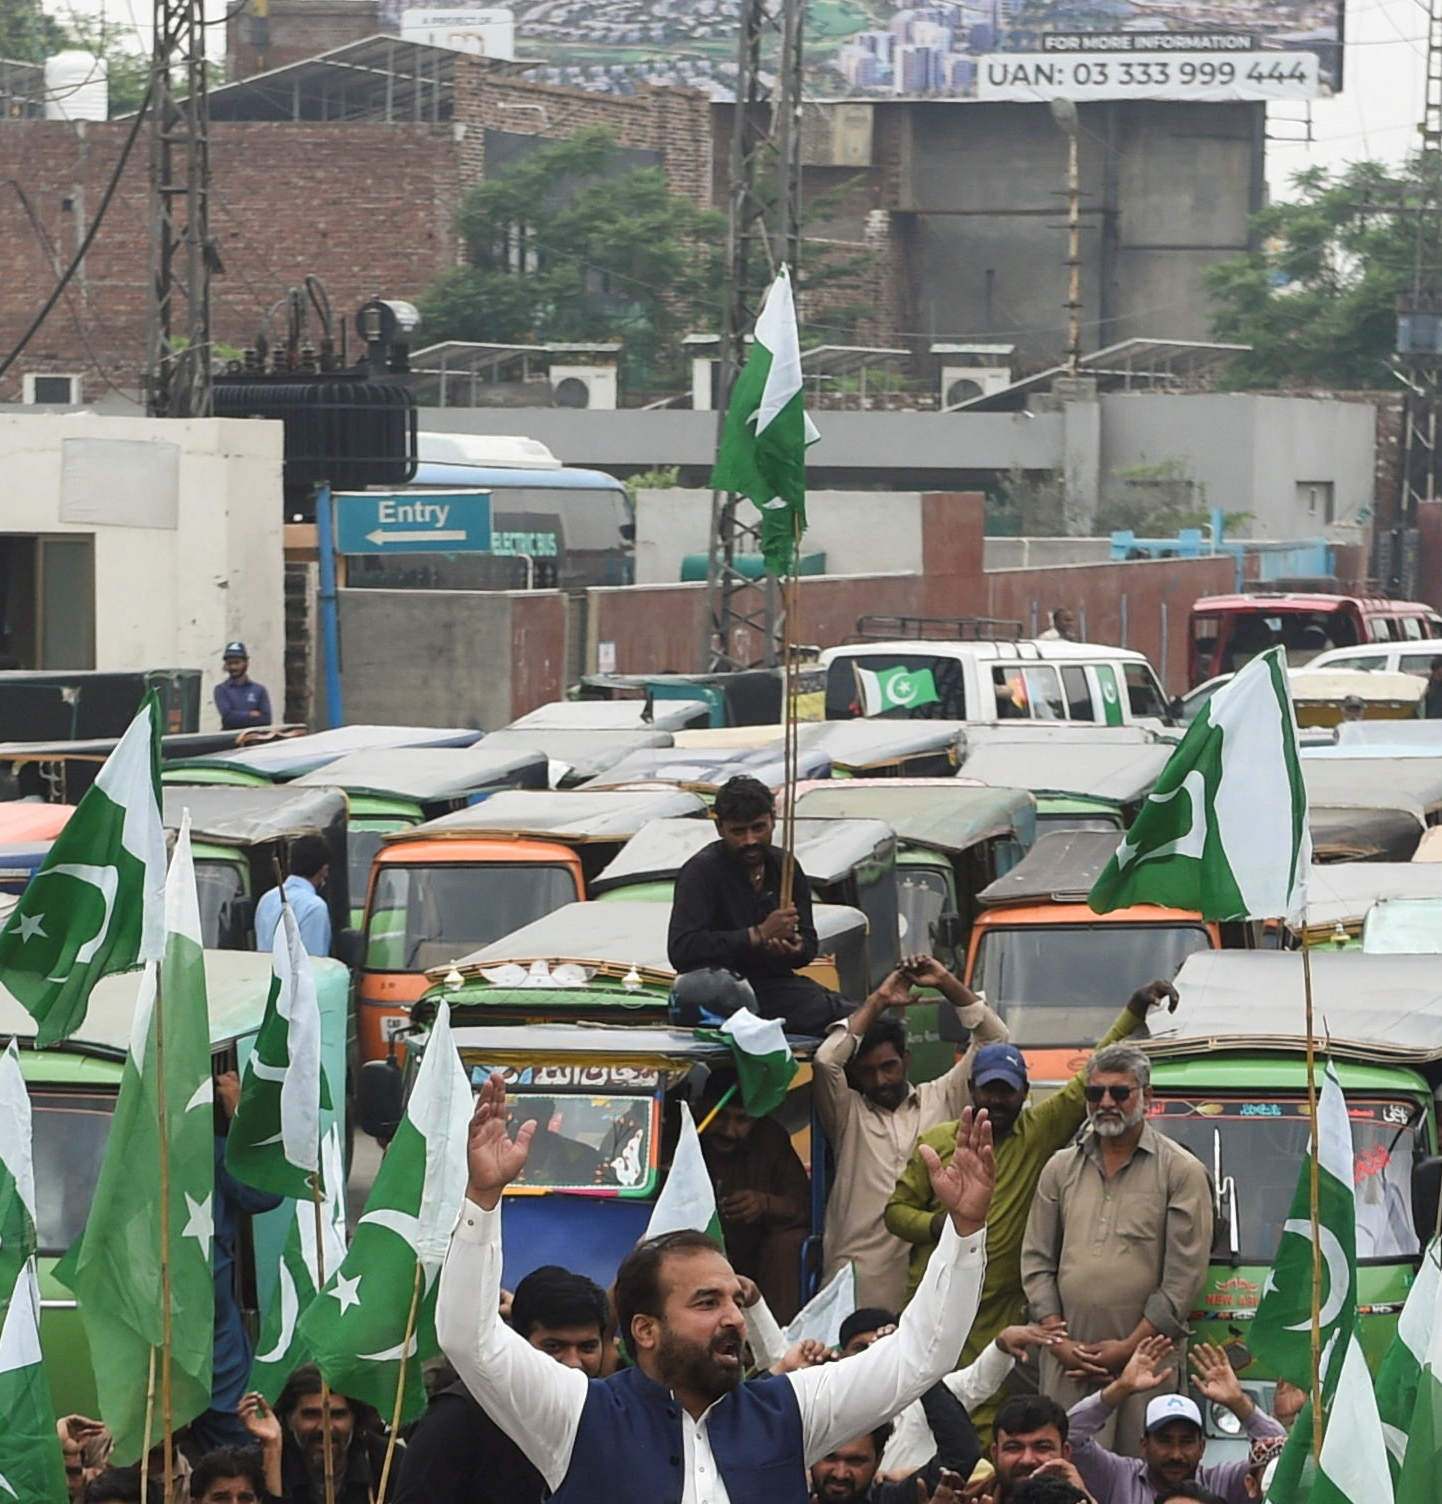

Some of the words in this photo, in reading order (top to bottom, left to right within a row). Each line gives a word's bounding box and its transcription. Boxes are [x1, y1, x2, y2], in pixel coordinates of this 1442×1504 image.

[1045, 36, 1080, 50] FOR
[1083, 36, 1132, 50] MORE
[1134, 35, 1252, 50] INFORMATION
[988, 62, 1063, 87] UAN:
[1073, 62, 1109, 86] 03
[1119, 62, 1170, 86] 333
[1179, 62, 1236, 86] 999
[1246, 61, 1308, 86] 444
[378, 501, 451, 527] Entry
